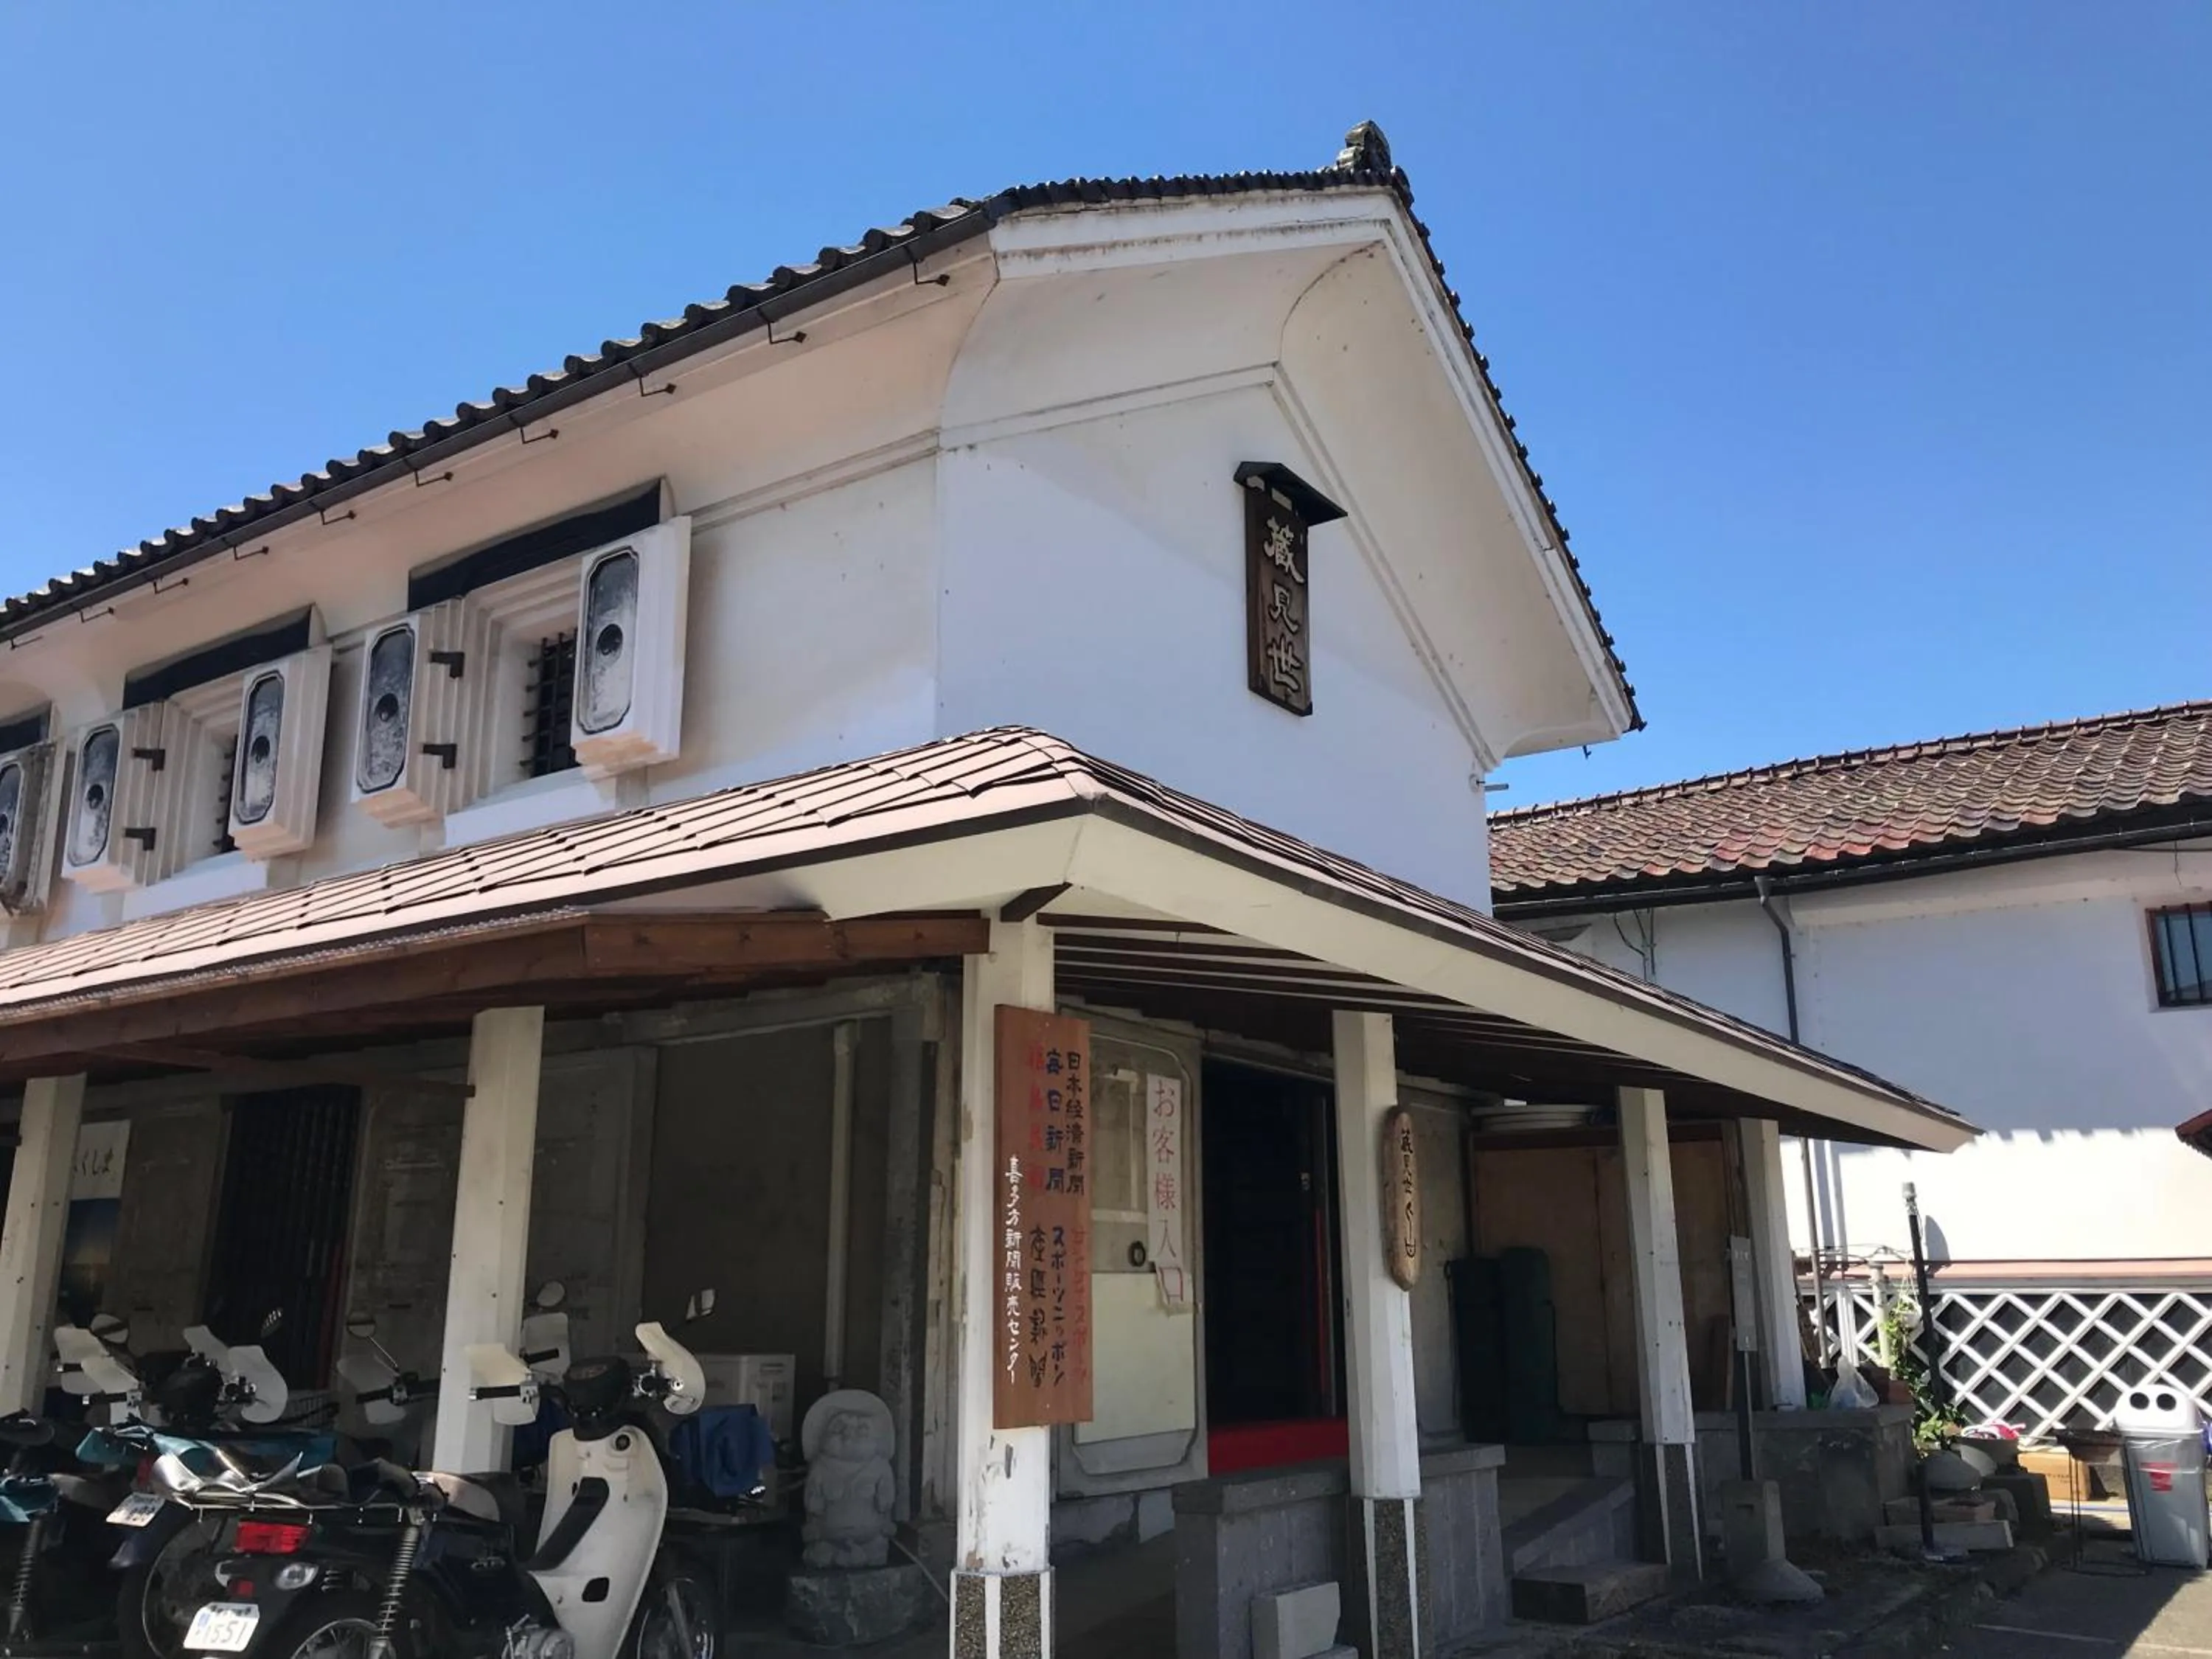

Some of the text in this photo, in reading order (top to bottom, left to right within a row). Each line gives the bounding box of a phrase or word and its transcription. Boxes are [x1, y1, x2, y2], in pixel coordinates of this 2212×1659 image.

[1066, 1051, 1085, 1196] 日本経済新聞
[1152, 1079, 1184, 1304] お客様入口
[1005, 1154, 1023, 1385] 喜多方新聞販売センター
[1051, 1226, 1066, 1388] スポーツニッポン
